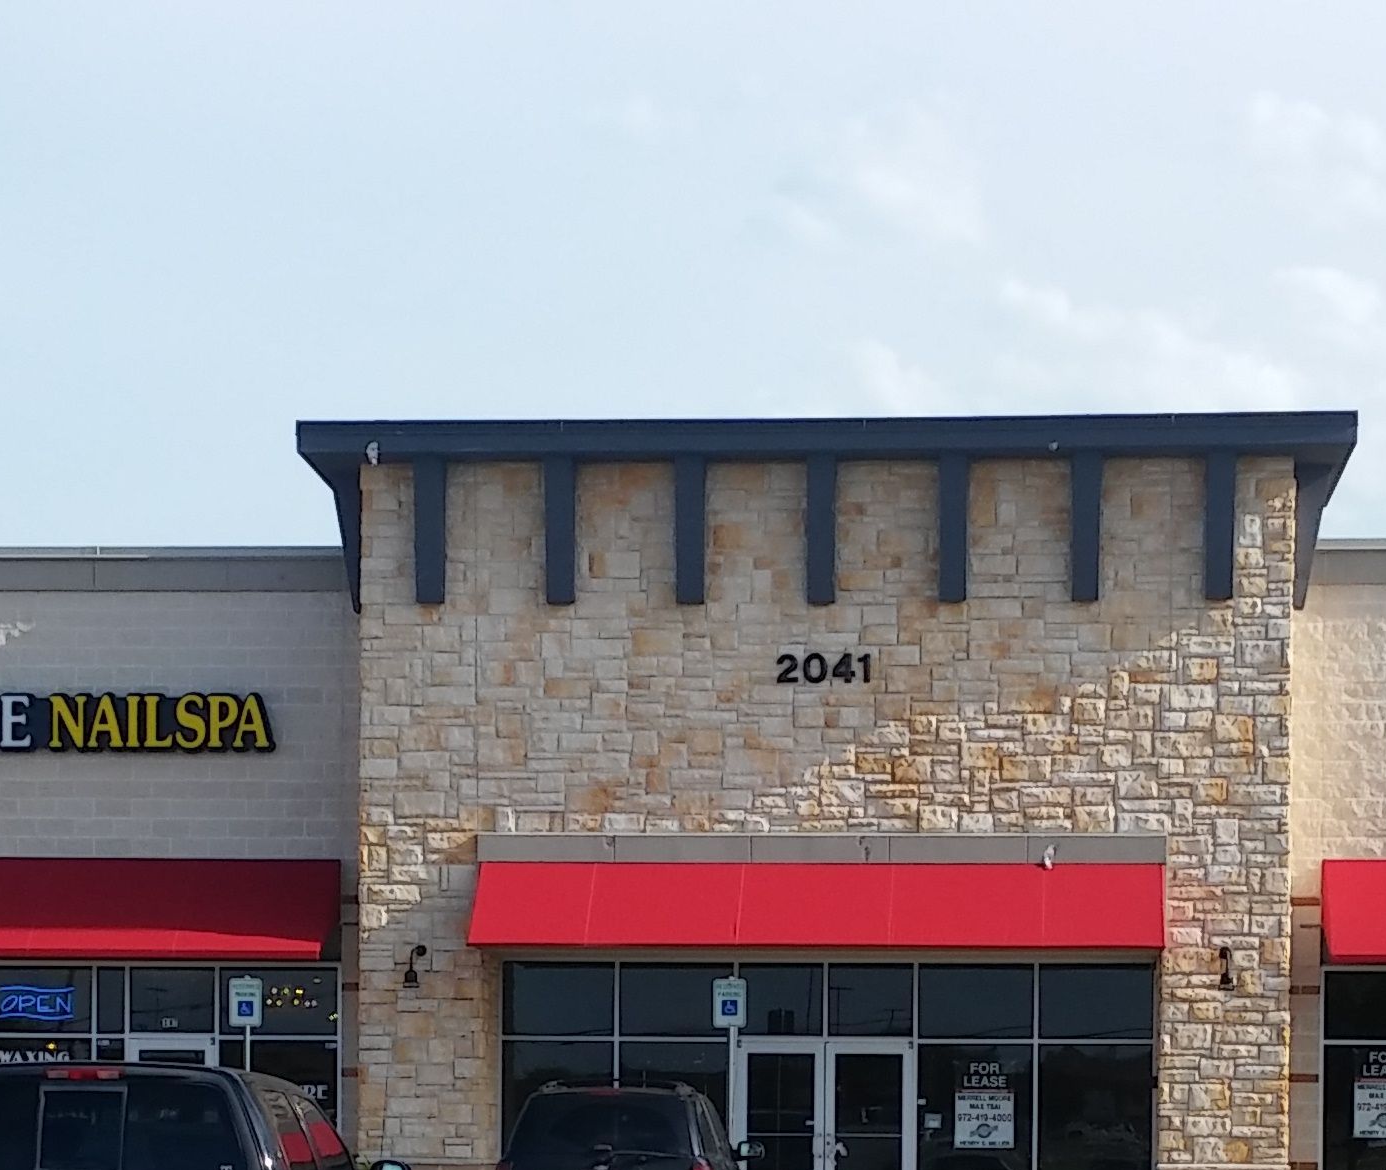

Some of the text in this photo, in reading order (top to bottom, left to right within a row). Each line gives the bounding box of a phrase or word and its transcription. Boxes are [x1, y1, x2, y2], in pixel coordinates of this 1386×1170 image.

[776, 652, 871, 683] 2041
[0, 992, 73, 1014] OPEN
[969, 1062, 1000, 1075] FOR
[963, 1075, 1008, 1088] LEASE
